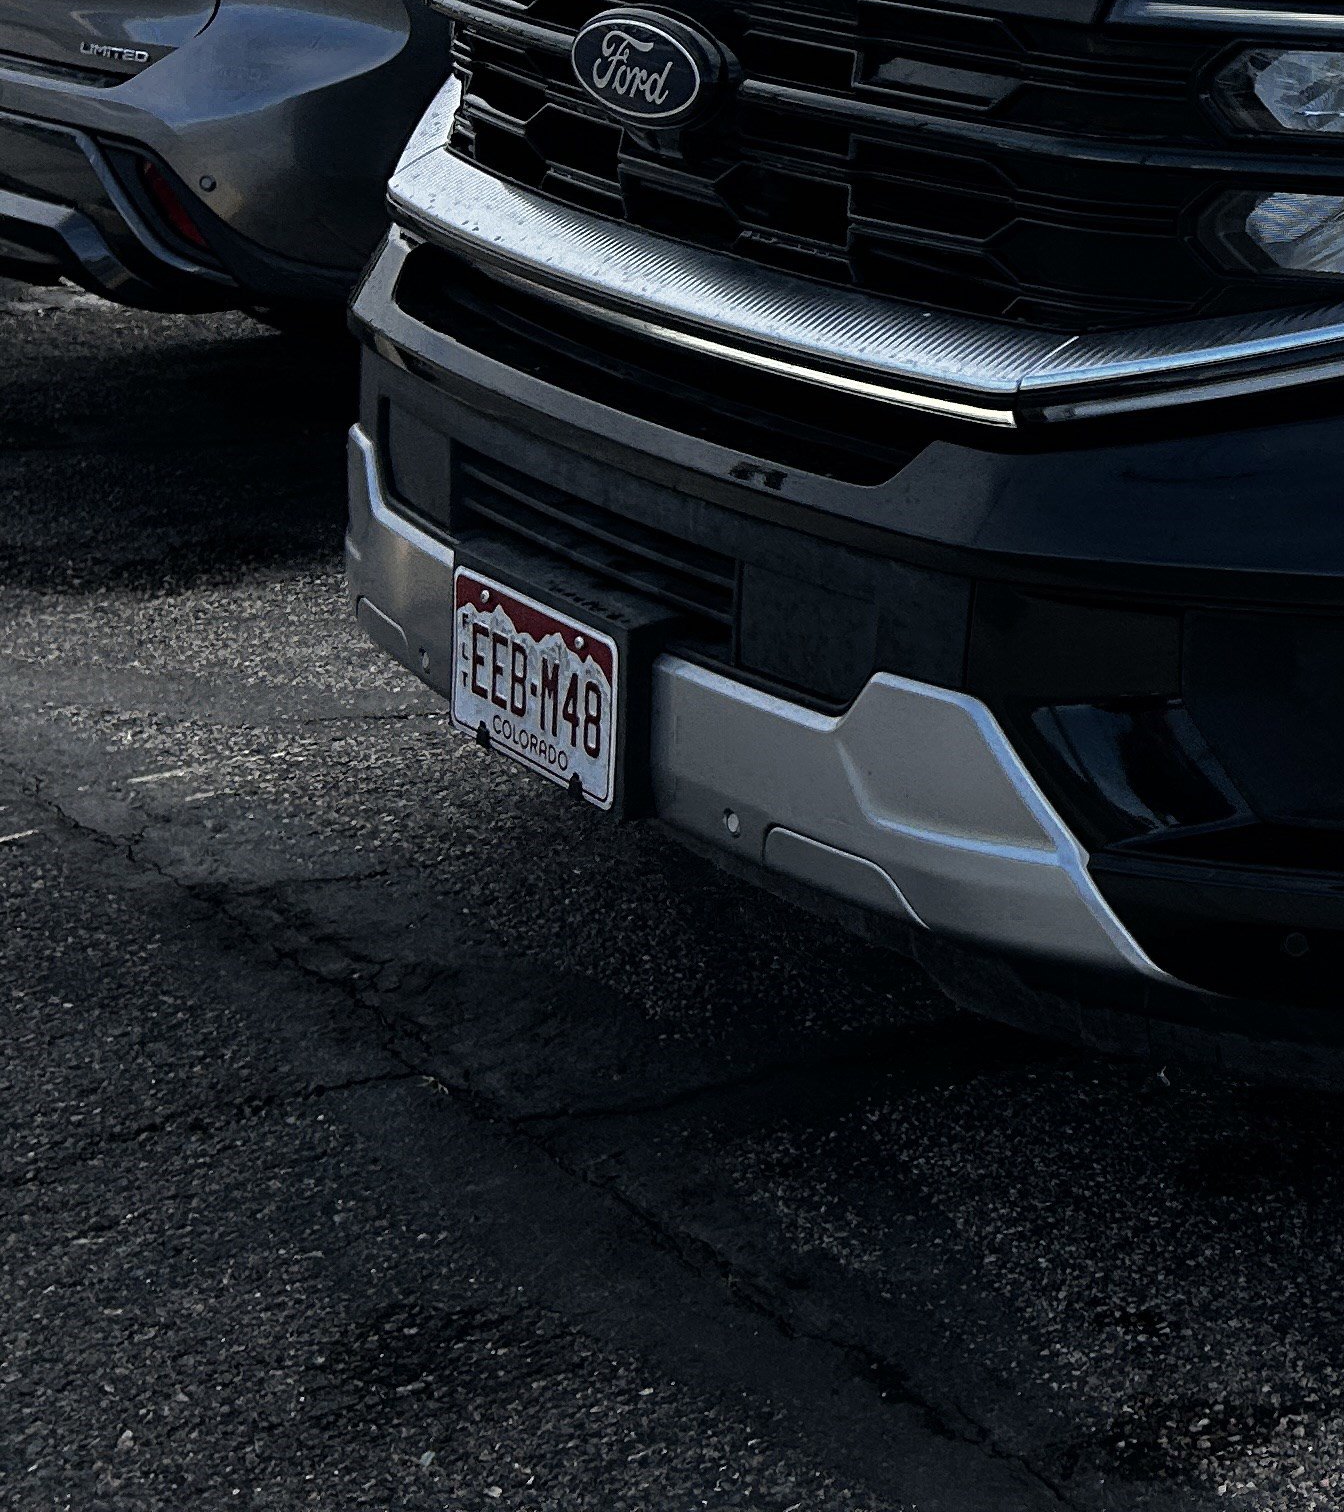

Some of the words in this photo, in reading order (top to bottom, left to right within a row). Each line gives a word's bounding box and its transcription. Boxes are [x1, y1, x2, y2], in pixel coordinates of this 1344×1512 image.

[80, 40, 149, 63] LIMITED
[594, 29, 672, 106] Ford
[492, 714, 568, 771] COLORADO
